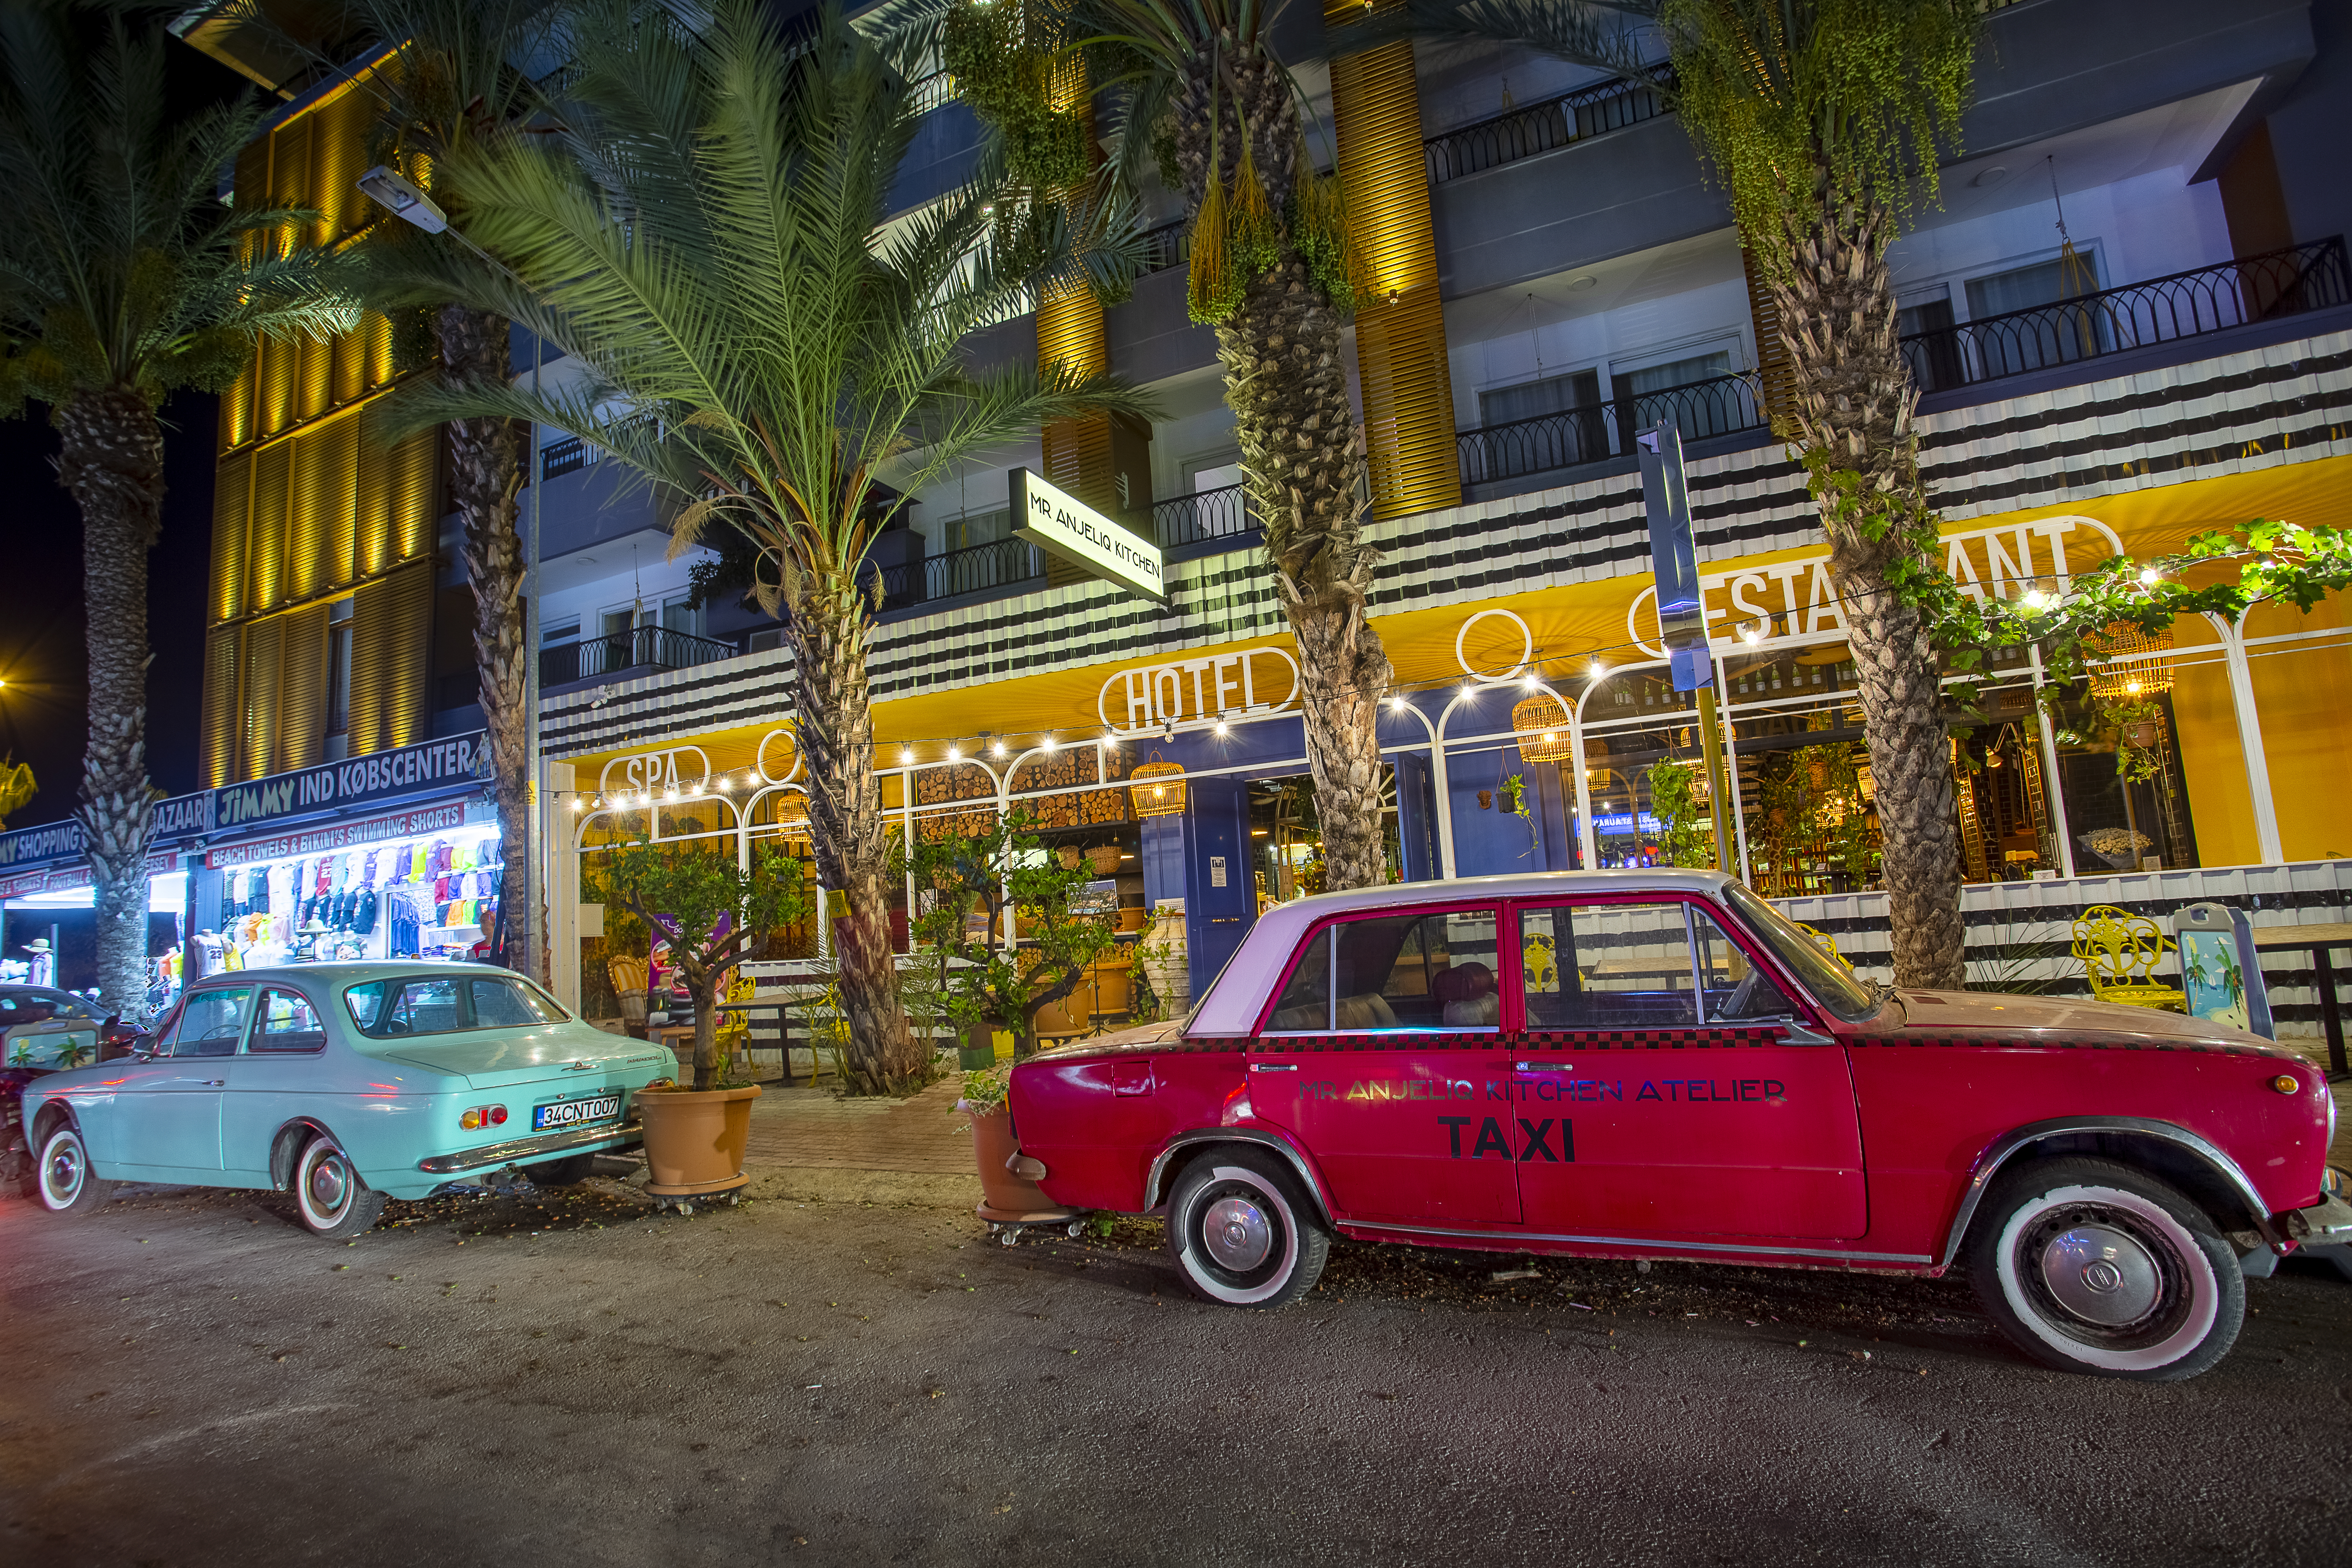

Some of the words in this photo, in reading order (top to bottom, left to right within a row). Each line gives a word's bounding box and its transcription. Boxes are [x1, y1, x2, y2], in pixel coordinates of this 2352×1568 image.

[1030, 492, 1052, 519] MR
[1056, 508, 1111, 552] ANJELIQ
[1115, 540, 1160, 579] KITCHEN
[1125, 655, 1270, 730] HOTEL
[299, 771, 334, 806] IND
[339, 740, 470, 799] KØBSCENTER
[627, 752, 681, 801] SPA
[17, 825, 80, 860] SHOPPING
[212, 847, 246, 867] BEACH
[247, 839, 288, 861] TOWELS
[291, 837, 298, 853] &
[409, 806, 459, 833] SHORTS
[145, 856, 170, 873] ERSEY
[210, 950, 222, 959] 23
[1299, 1081, 1338, 1100] MR
[1347, 1080, 1475, 1100] ANJELIQ
[1487, 1080, 1623, 1101] KITCHEN
[1636, 1080, 1788, 1102] ATELIER
[1437, 1116, 1575, 1163] TAXI
